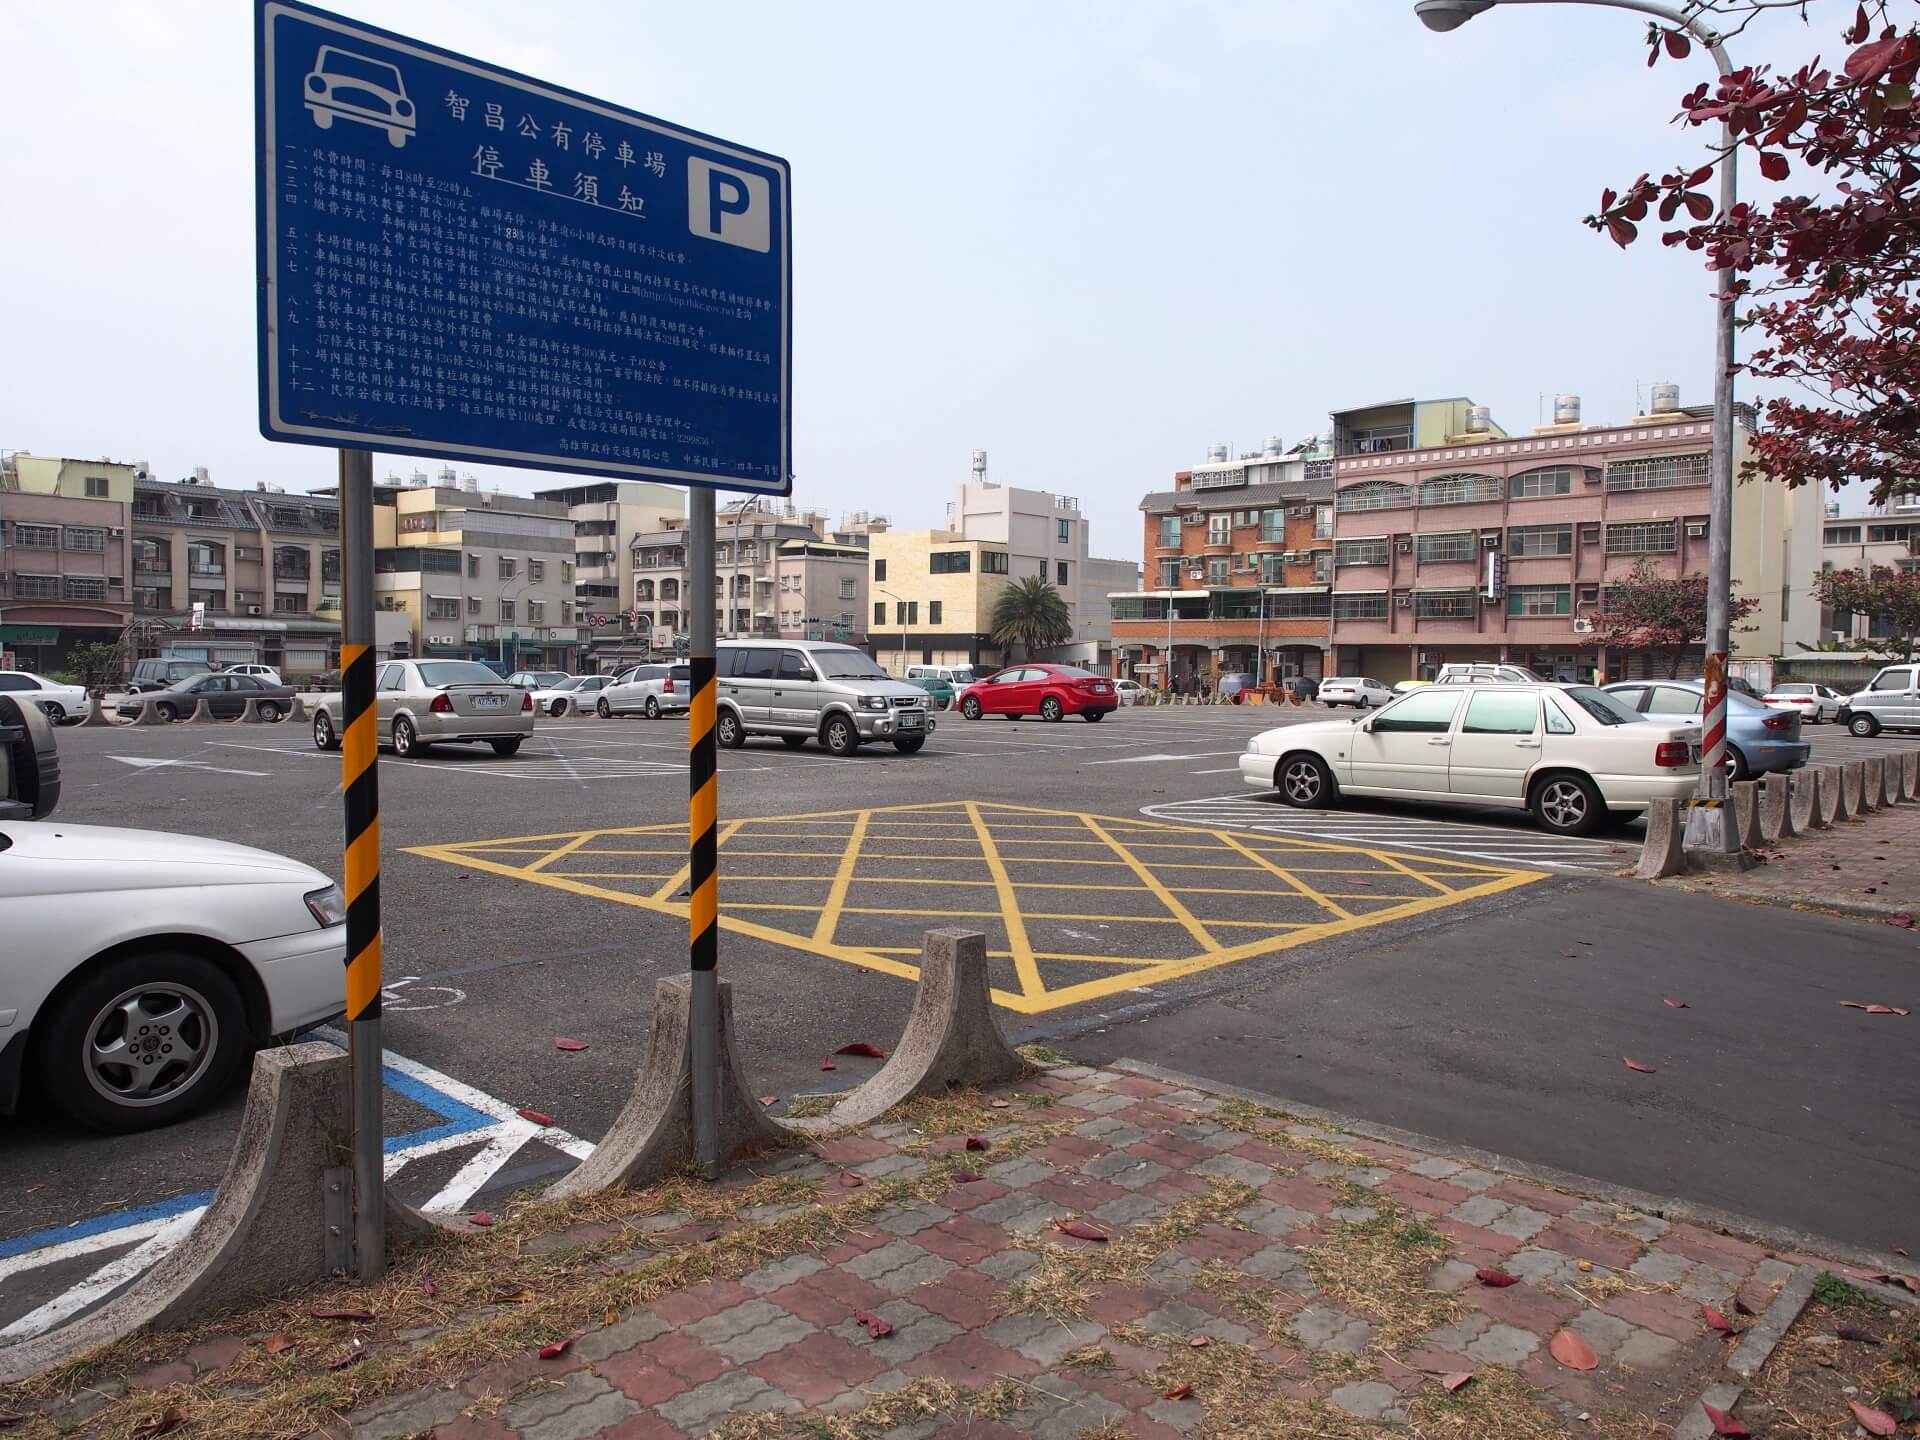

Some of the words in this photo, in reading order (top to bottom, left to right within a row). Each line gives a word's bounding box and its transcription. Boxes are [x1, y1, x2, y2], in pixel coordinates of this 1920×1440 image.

[444, 88, 667, 179] 智昌公有停車場
[471, 144, 646, 212] 停車須知
[709, 167, 751, 235] P
